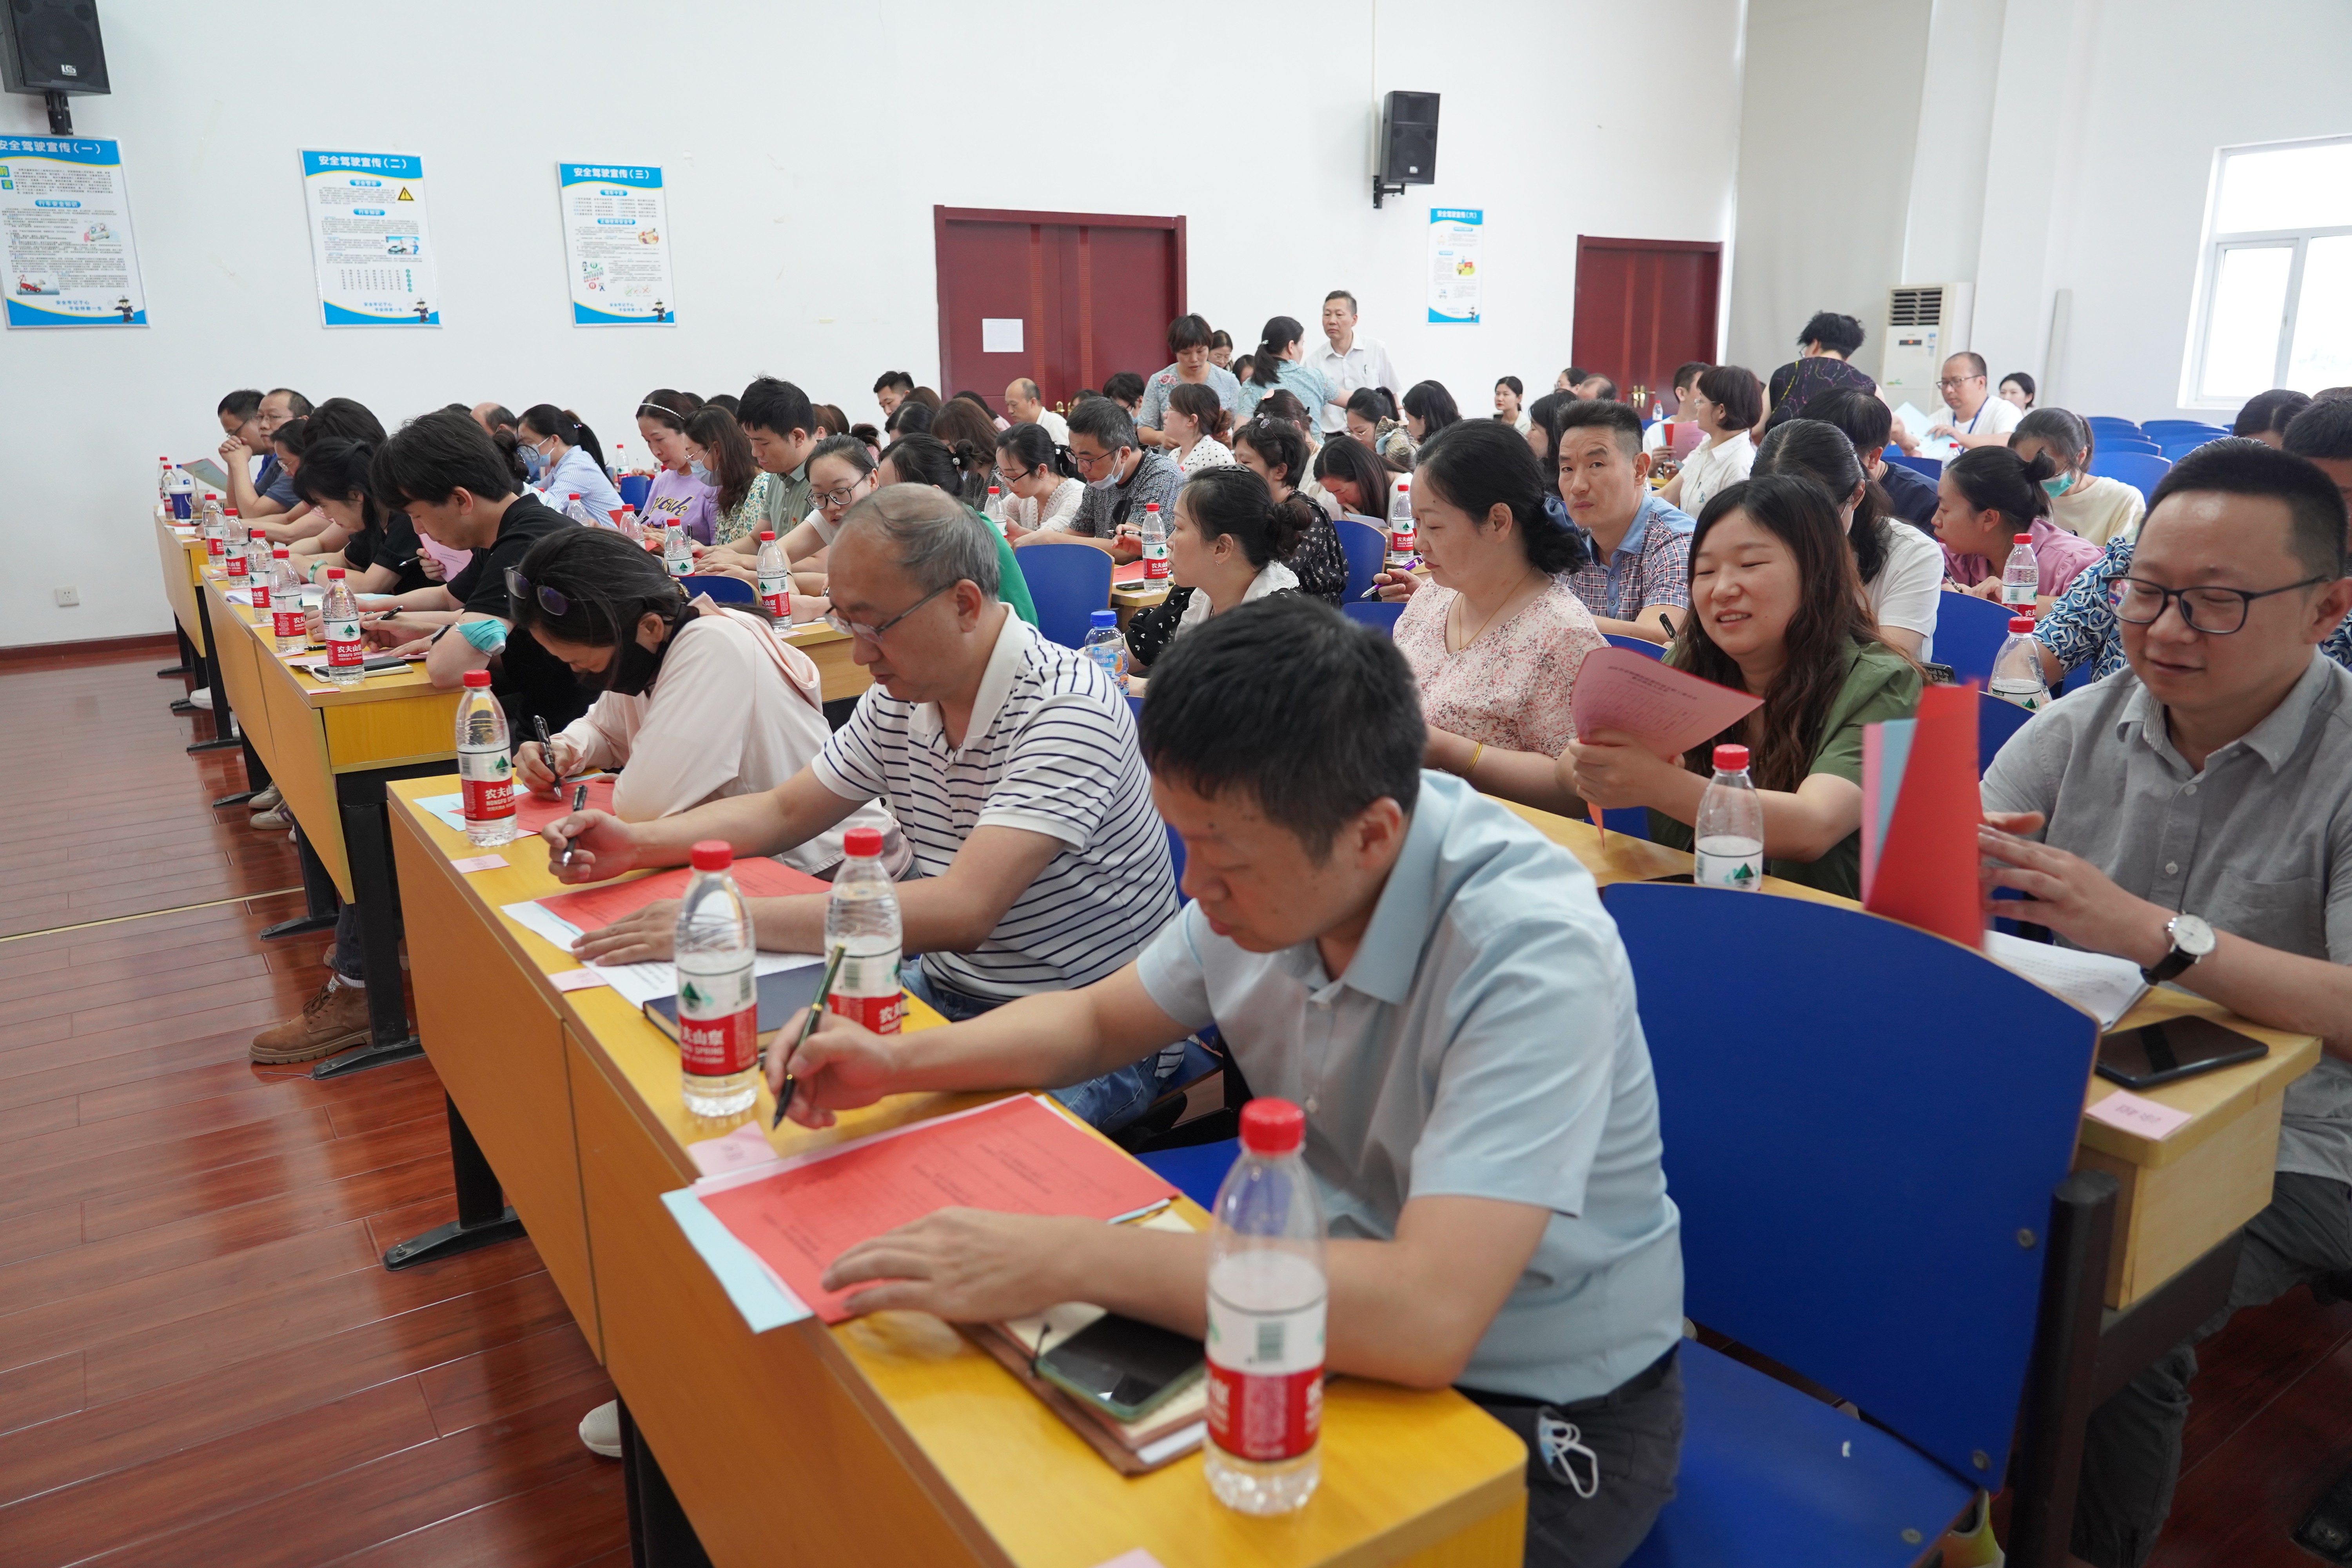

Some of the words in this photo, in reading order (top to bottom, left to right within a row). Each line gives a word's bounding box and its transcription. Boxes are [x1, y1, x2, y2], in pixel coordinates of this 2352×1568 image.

[319, 155, 407, 169] 安全驾驶宣传（二）
[573, 168, 649, 179] 安全驾驶宣传（三）
